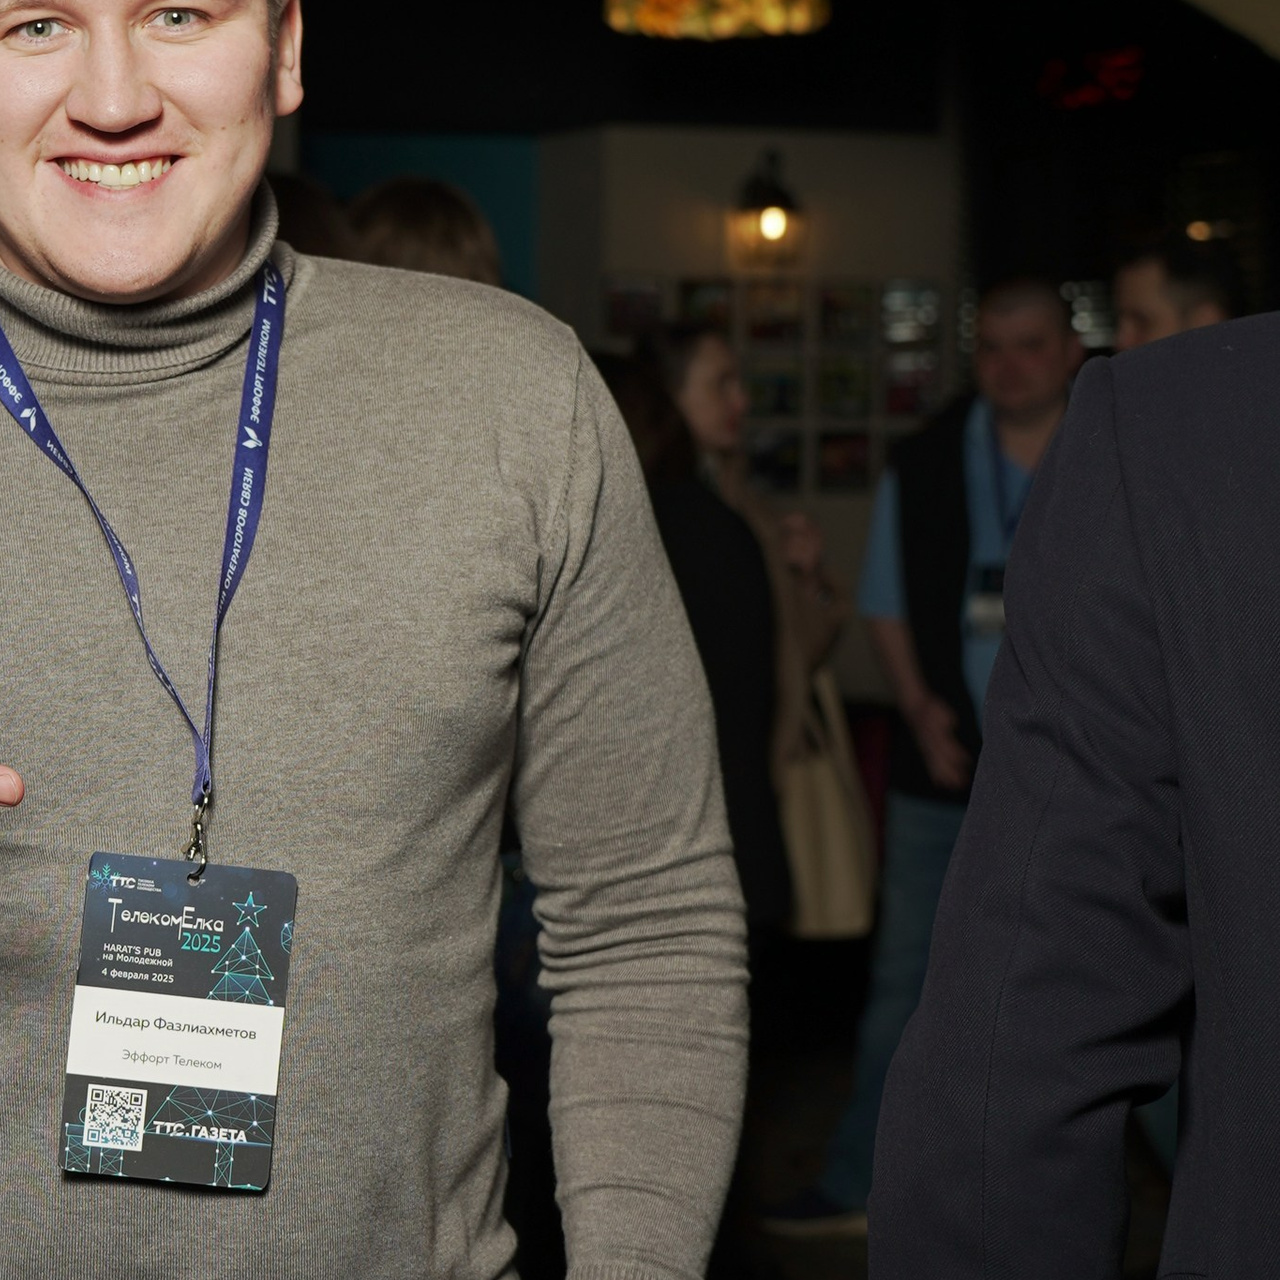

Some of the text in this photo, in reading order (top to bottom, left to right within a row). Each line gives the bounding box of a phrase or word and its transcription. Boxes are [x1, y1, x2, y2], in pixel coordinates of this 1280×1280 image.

[250, 318, 272, 423] ЭФФОРТ ТЕЛЕКОМ
[224, 467, 254, 590] ОПЕРАТОРОВ СВЯЗИ
[103, 942, 162, 957] HARAT'S PUB
[180, 931, 221, 953] 2025
[102, 952, 173, 967] на Молодежной
[101, 967, 175, 983] 4 февраля 2025
[95, 1010, 257, 1041] Ильдар Фазлиахметов
[122, 1048, 223, 1070] Эффорт Телеком
[153, 1120, 248, 1143] ТТС.ГАЗЕТА
